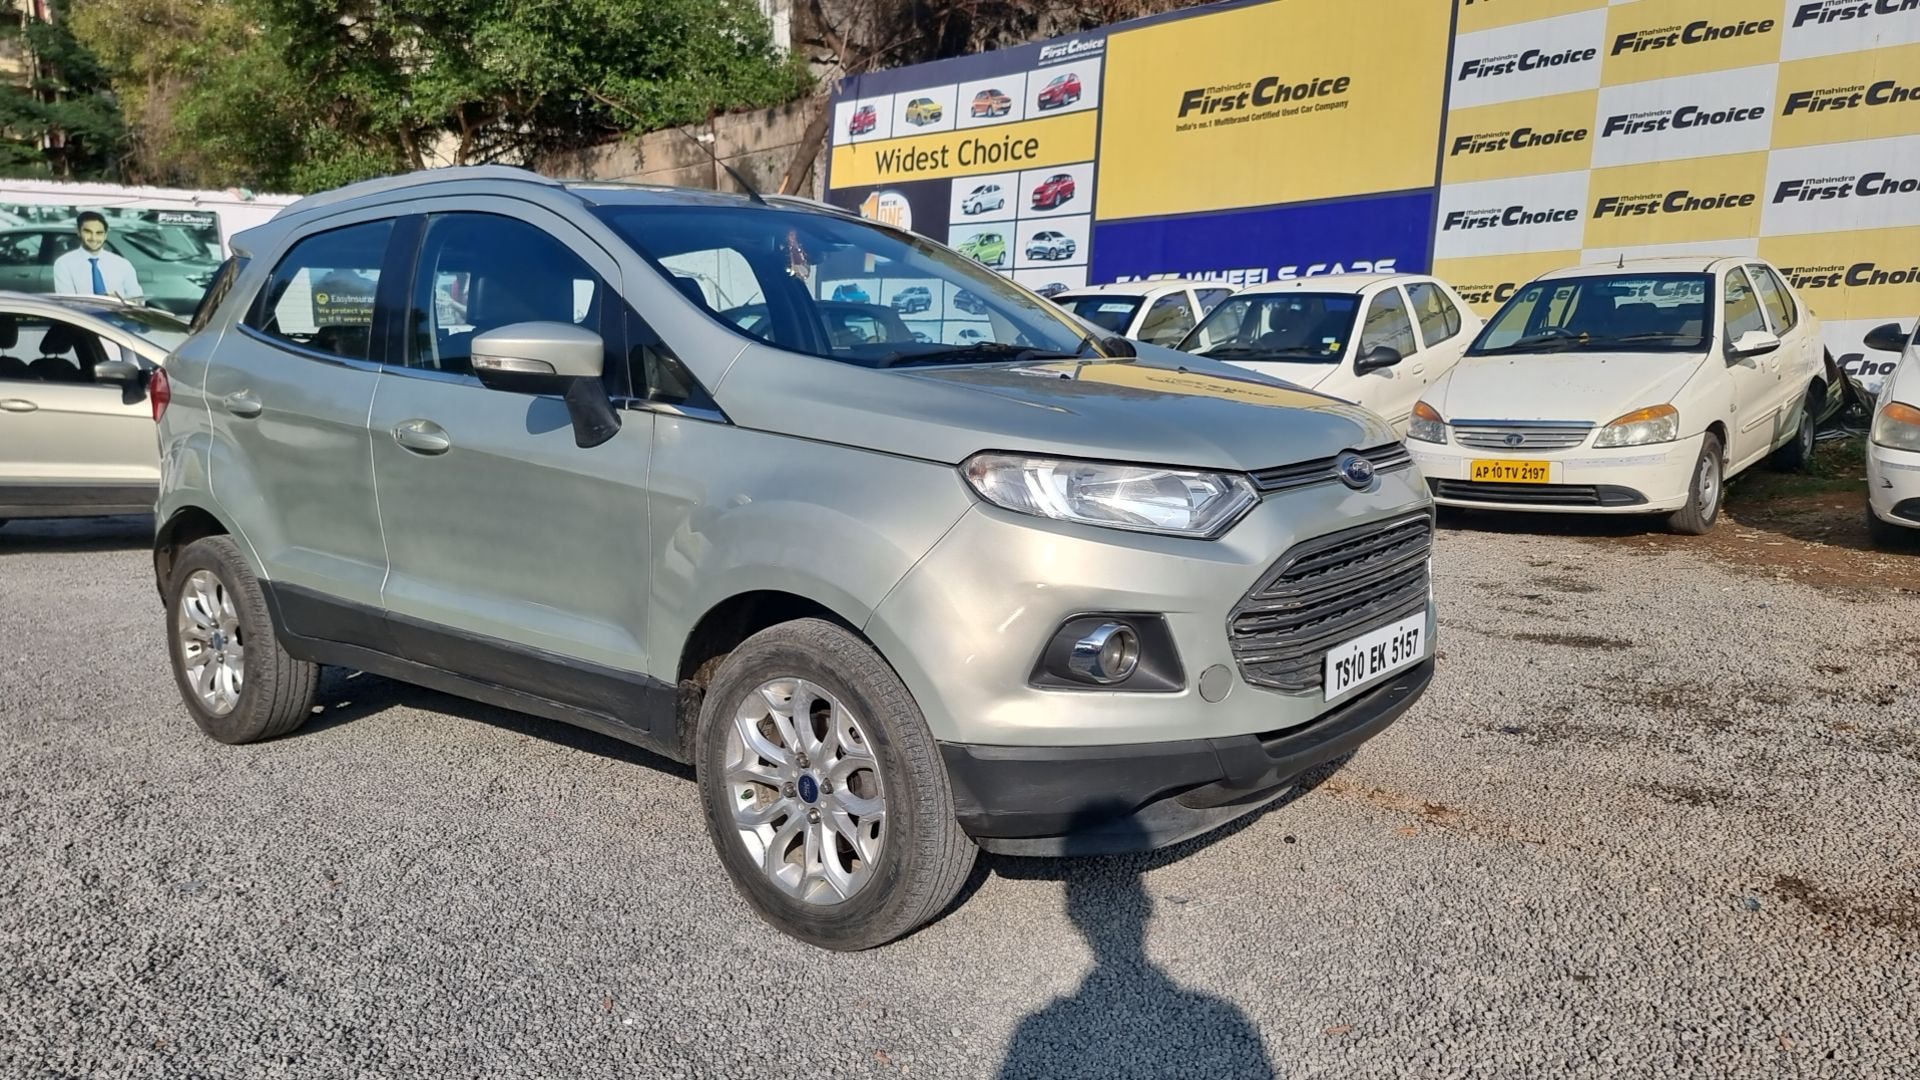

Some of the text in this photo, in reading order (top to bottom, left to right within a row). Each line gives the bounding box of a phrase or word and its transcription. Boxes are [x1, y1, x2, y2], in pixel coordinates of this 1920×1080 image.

[1792, 2, 1872, 28] First
[1039, 46, 1068, 60] First
[1067, 39, 1105, 54] Choice
[1610, 19, 1774, 56] First Choice
[1458, 48, 1597, 81] First Choice
[1177, 76, 1351, 118] First Choice
[1782, 90, 1863, 116] First
[1214, 114, 1250, 127] Multibrand
[1251, 110, 1280, 121] Certified
[1282, 108, 1299, 117] Used
[1300, 105, 1313, 114] Car
[1314, 100, 1349, 112] Company
[1601, 105, 1765, 138] First Choice
[875, 134, 1039, 175] Widest Choice
[1450, 127, 1588, 156] First Choice
[1772, 172, 1920, 204] First Cho
[1443, 205, 1579, 231] First Choice
[1592, 190, 1755, 219] First Choice
[1186, 266, 1298, 284] WHEELS
[331, 307, 359, 315] protect
[1475, 466, 1546, 480] AP 10 TV 2197
[1336, 628, 1419, 690] TS10 EK 5157
